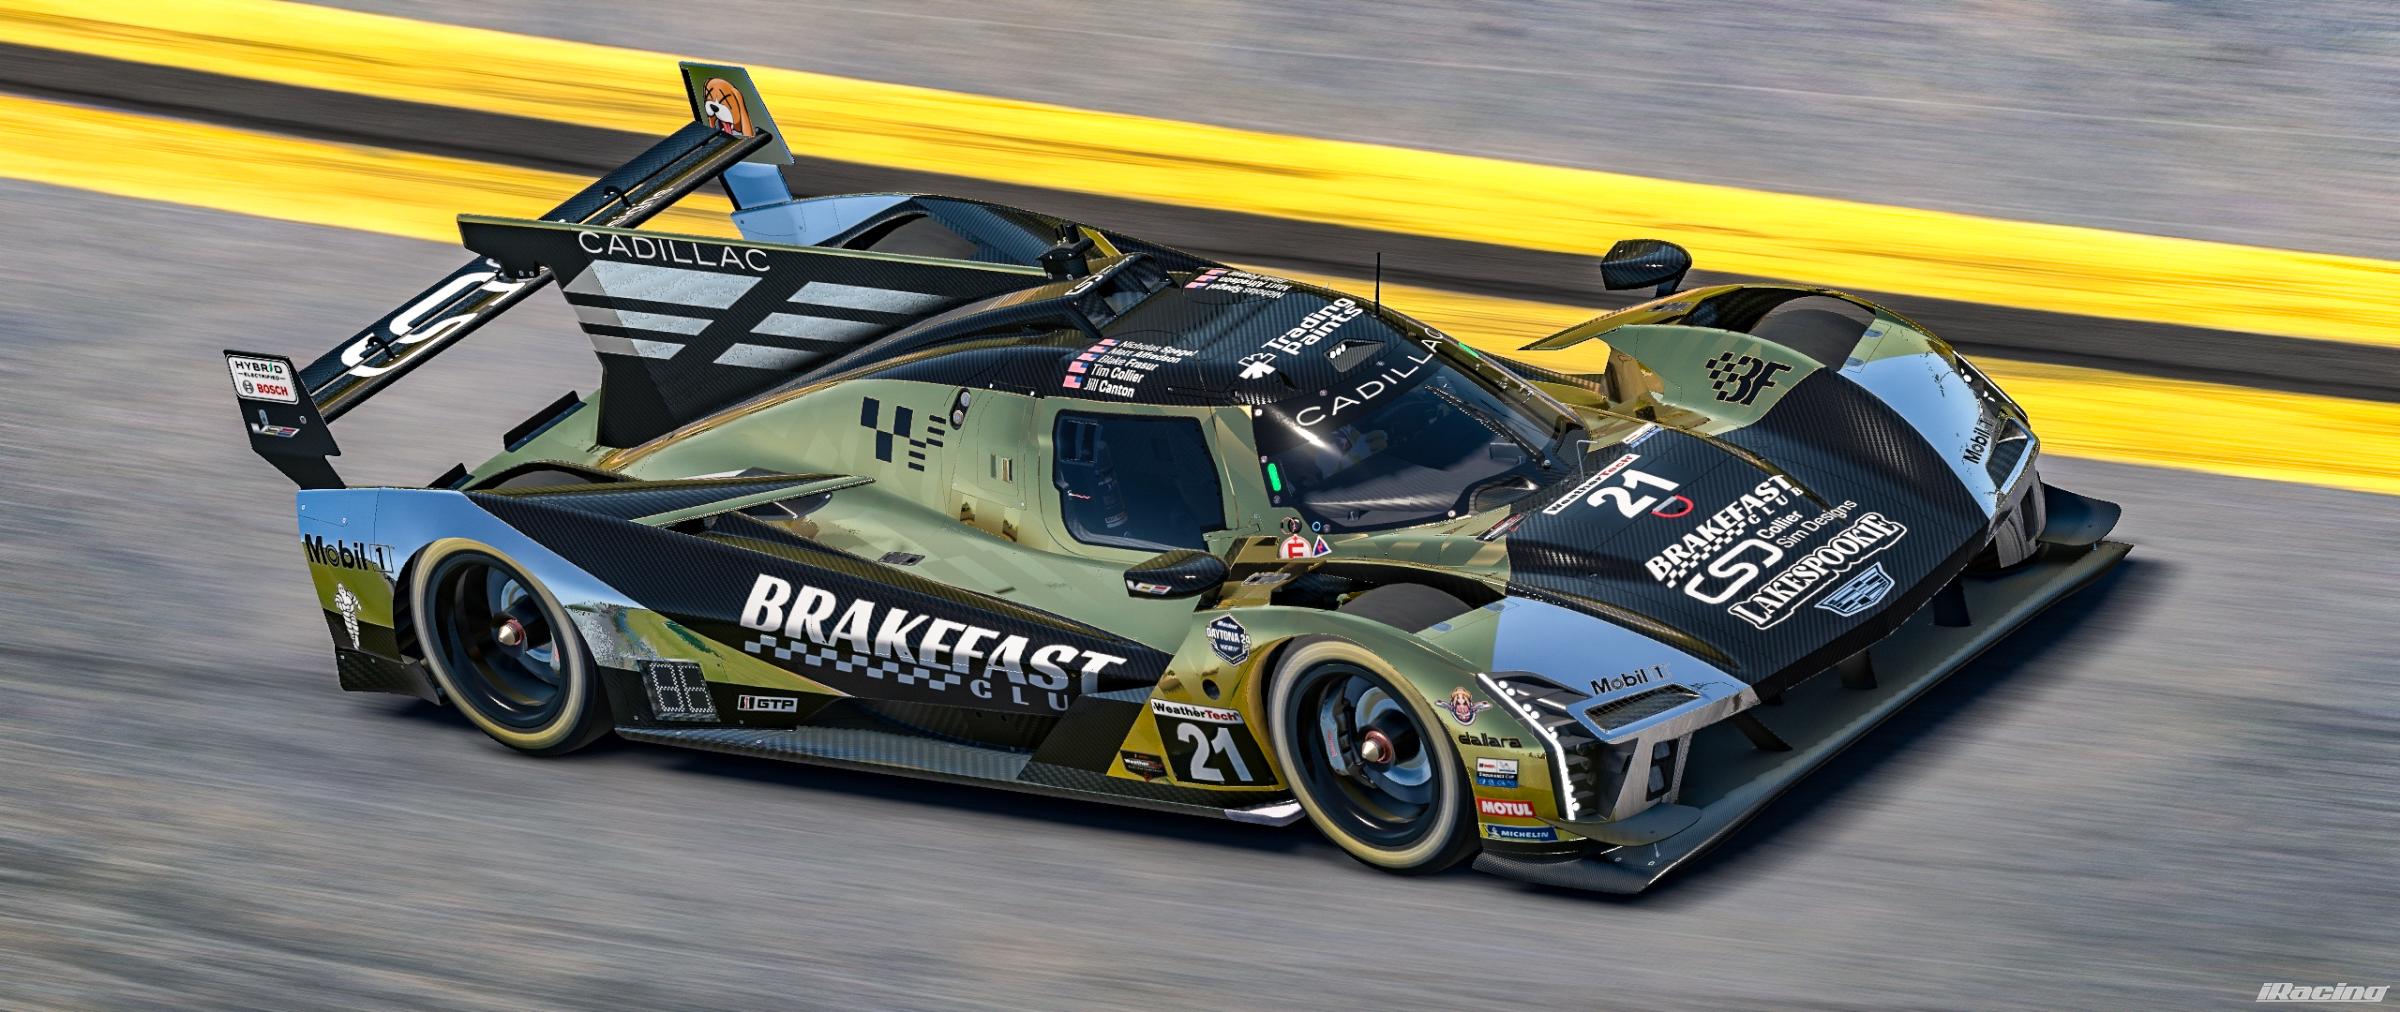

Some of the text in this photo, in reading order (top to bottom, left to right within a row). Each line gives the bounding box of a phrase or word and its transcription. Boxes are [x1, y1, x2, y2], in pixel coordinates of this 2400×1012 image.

[578, 231, 771, 272] CADILLAC
[1261, 298, 1356, 349] Trading
[1281, 306, 1363, 356] Paints
[235, 360, 283, 374] HYBRID
[1091, 363, 1144, 383] Tim Collier
[1297, 328, 1443, 426] CADILLAC
[256, 383, 289, 396] BOSCH
[1083, 378, 1135, 398] Jill Canton
[1963, 427, 1991, 464] Mobil
[1548, 455, 1633, 512] WeatherTech
[1586, 469, 1680, 519] 21
[1748, 487, 1804, 525] CLUB
[1756, 510, 1803, 539] Collier
[1776, 500, 1858, 549] Sim Designs
[1644, 474, 1793, 582] BRAKEFAST
[304, 533, 368, 571] Mobil
[1730, 514, 1901, 626] LAKESPOOKIE
[740, 573, 1127, 696] BRAKEFAST
[1206, 628, 1240, 644] DAYTONA
[970, 679, 1070, 713] CLU
[1590, 669, 1648, 695] Mobil
[757, 698, 795, 710] GTP
[1153, 701, 1238, 721] WeatherTech
[1177, 722, 1254, 782] 21
[1458, 731, 1523, 748] dallara
[1481, 800, 1533, 816] MOTUL
[1501, 830, 1549, 838] MICHELIN
